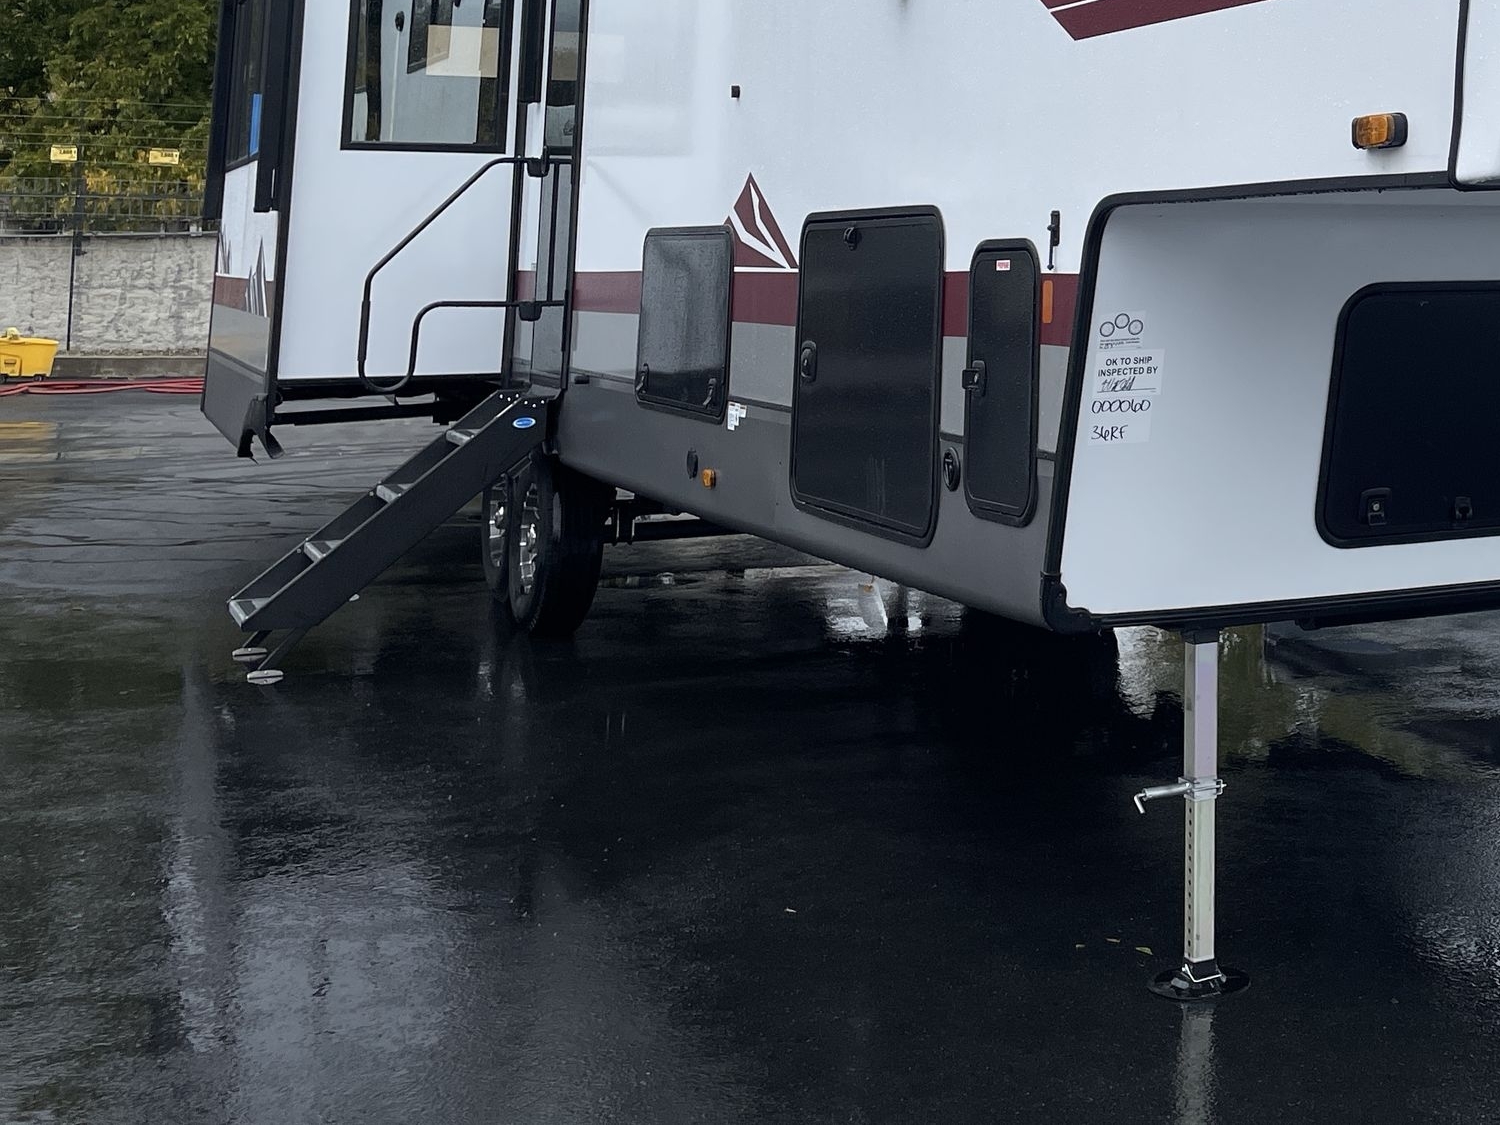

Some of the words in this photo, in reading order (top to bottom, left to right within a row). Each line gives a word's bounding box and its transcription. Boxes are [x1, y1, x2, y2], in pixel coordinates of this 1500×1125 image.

[1105, 358, 1118, 366] OK
[1120, 357, 1131, 365] TO
[1133, 356, 1153, 365] SHIP
[1098, 366, 1145, 377] INSPECTED
[1146, 366, 1158, 374] BY
